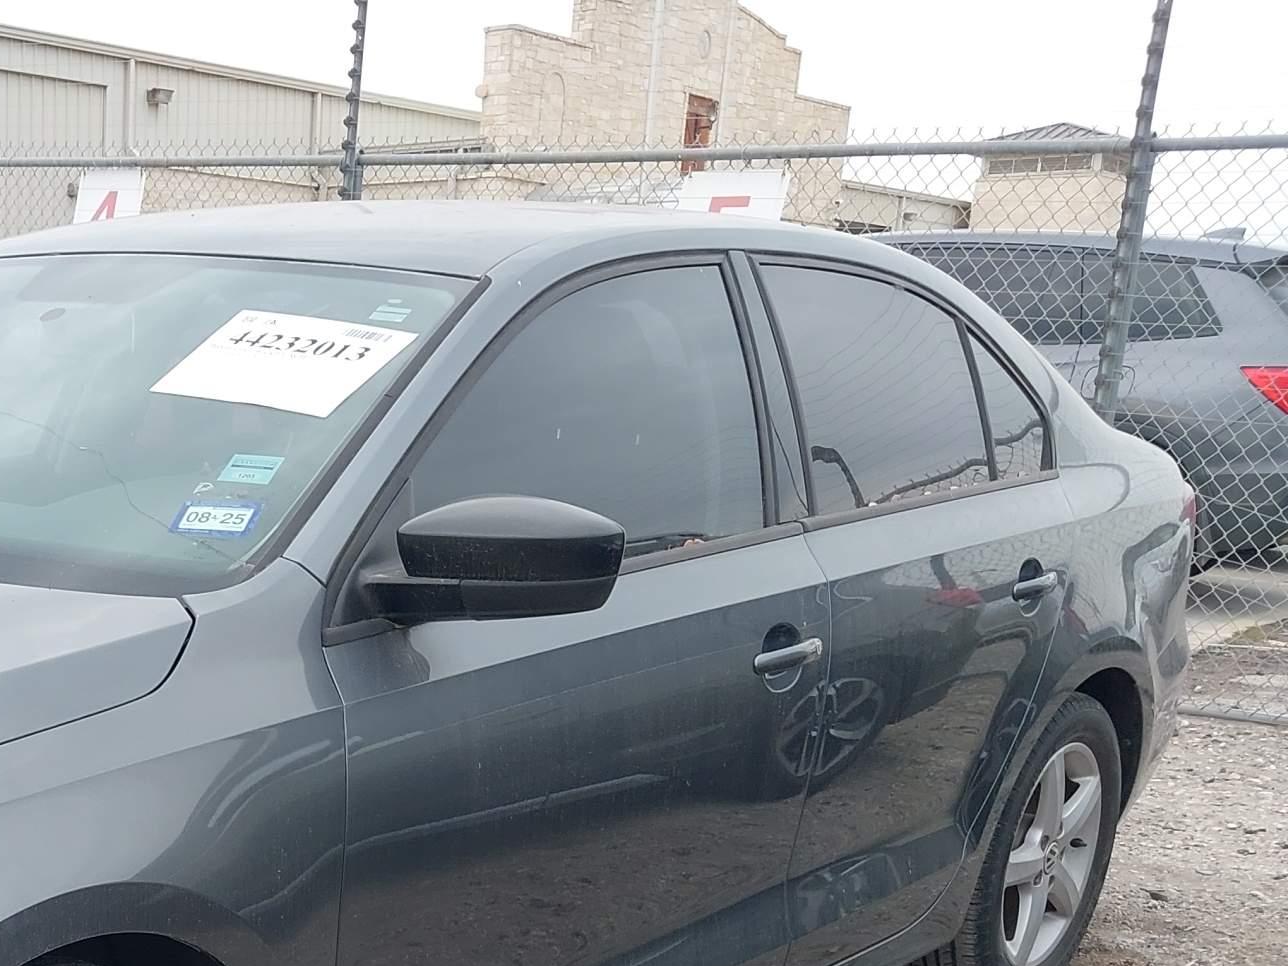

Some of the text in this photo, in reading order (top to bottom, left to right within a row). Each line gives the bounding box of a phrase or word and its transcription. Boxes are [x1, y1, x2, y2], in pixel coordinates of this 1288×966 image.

[228, 329, 372, 362] 44232013
[185, 510, 248, 526] 08 25
